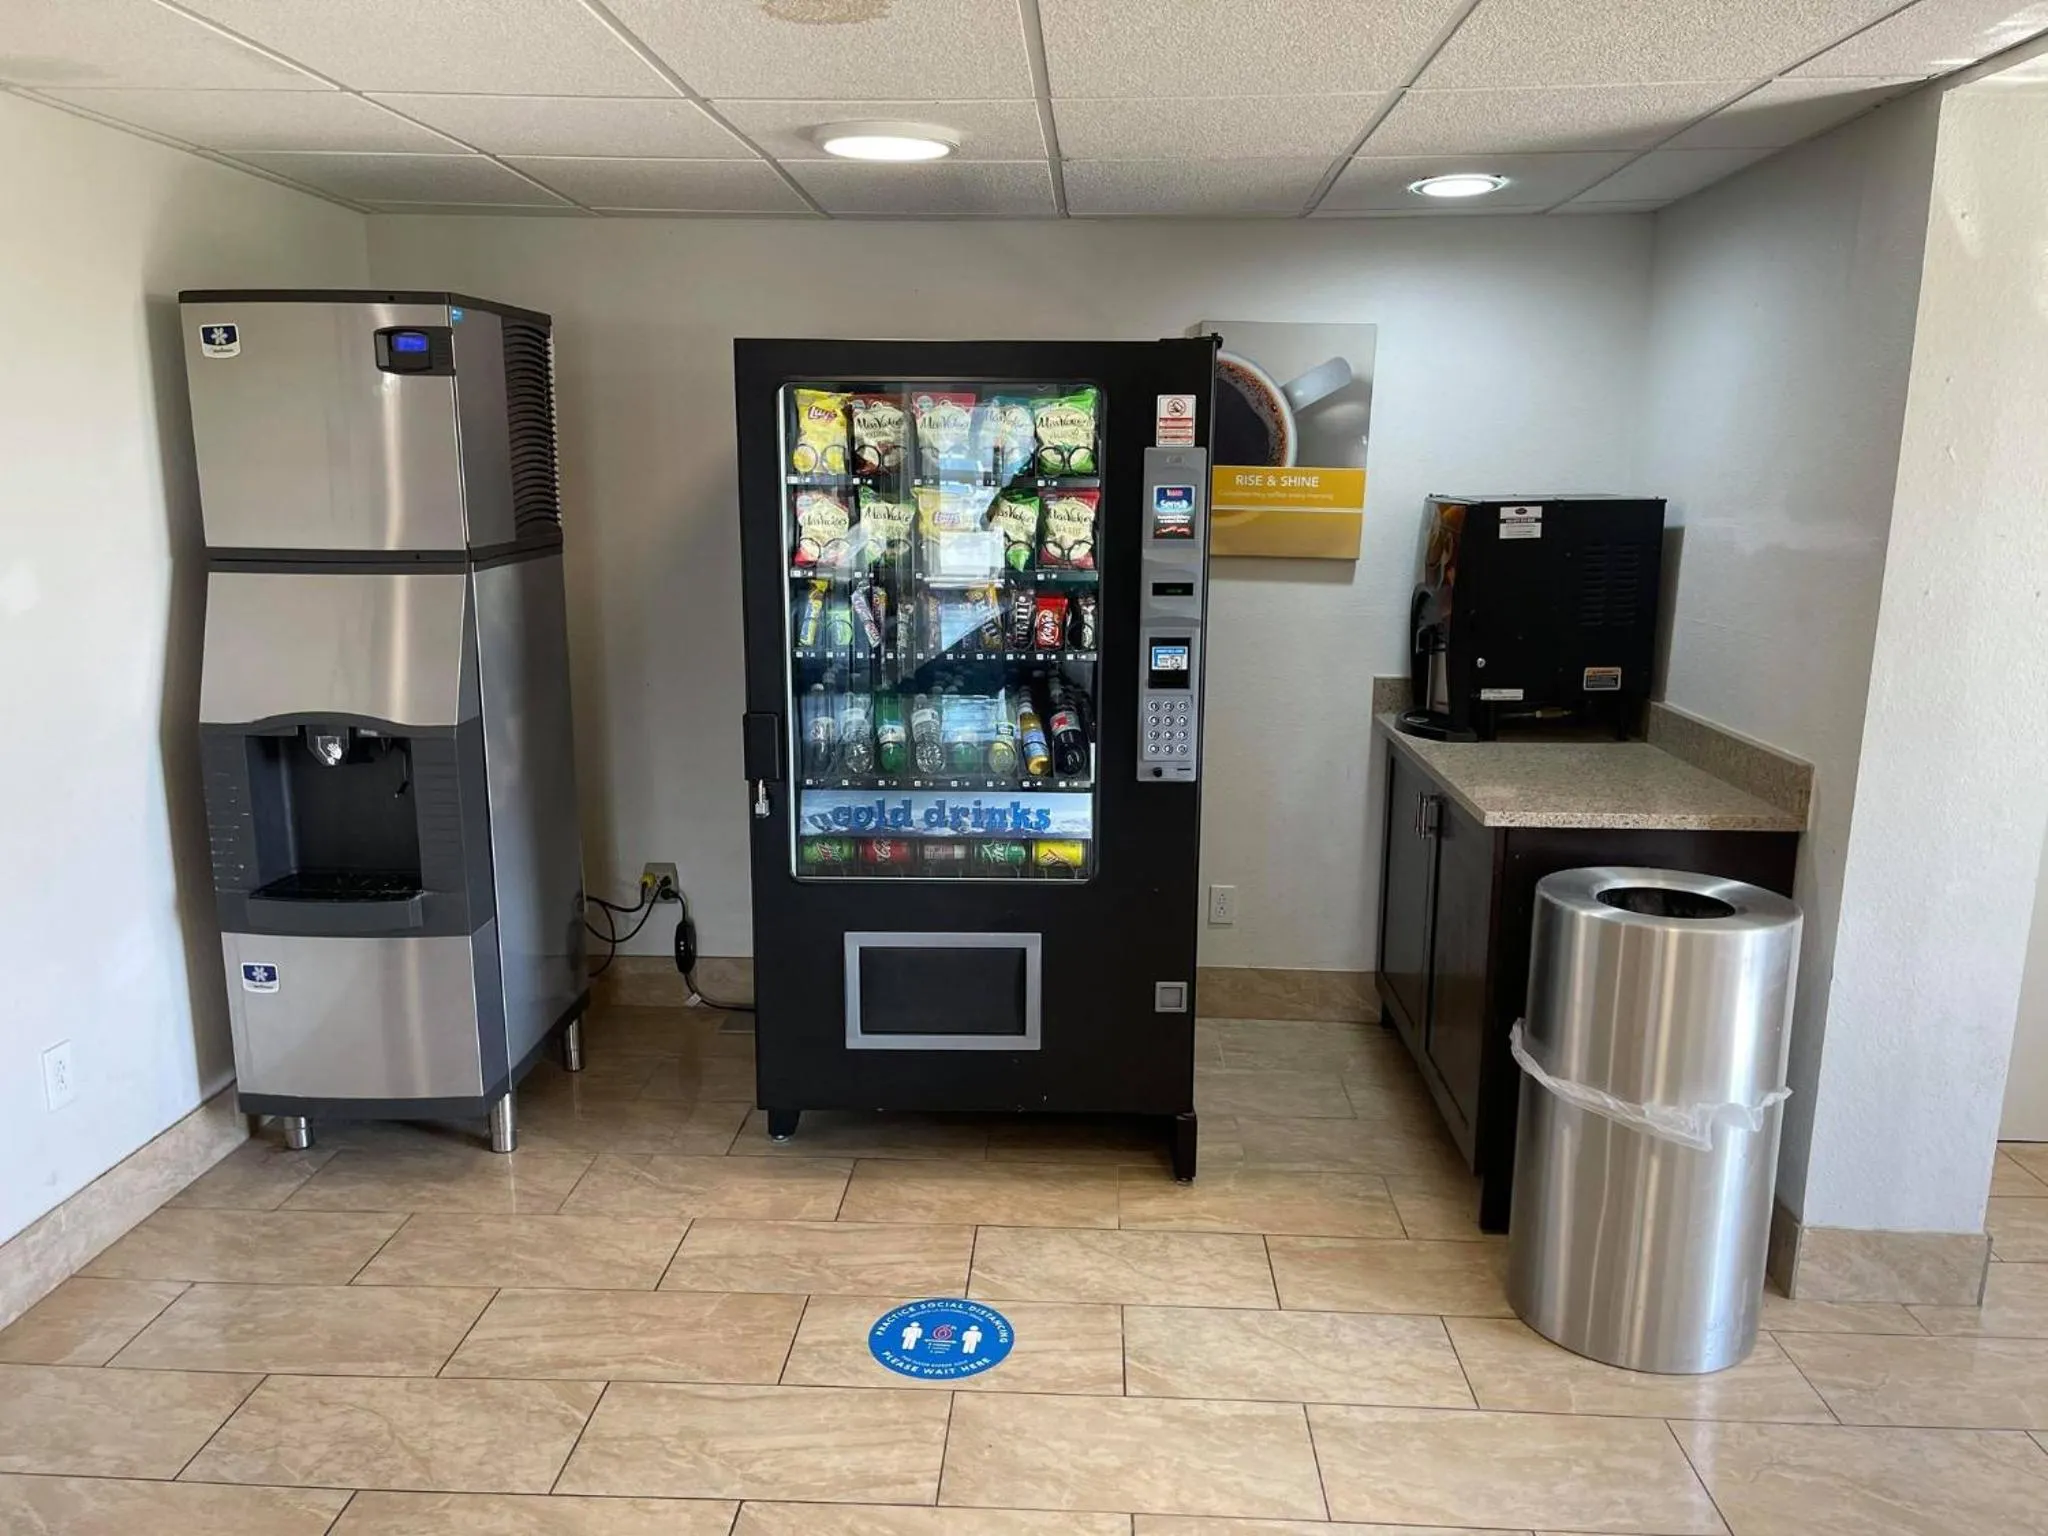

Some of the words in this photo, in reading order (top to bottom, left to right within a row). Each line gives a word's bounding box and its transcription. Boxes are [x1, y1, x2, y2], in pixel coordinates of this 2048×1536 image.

[1235, 474, 1262, 487] RISE
[1266, 475, 1277, 487] &
[1280, 475, 1320, 488] SHINE
[831, 798, 914, 830] cold
[923, 798, 1051, 831] drinks
[875, 1306, 917, 1336] PRACTICE
[919, 1301, 964, 1310] SOCIAL
[967, 1305, 1009, 1343] DISTANCING
[881, 1350, 920, 1373] PLEASE
[923, 1367, 955, 1375] WAIT
[960, 1357, 992, 1372] HERE
